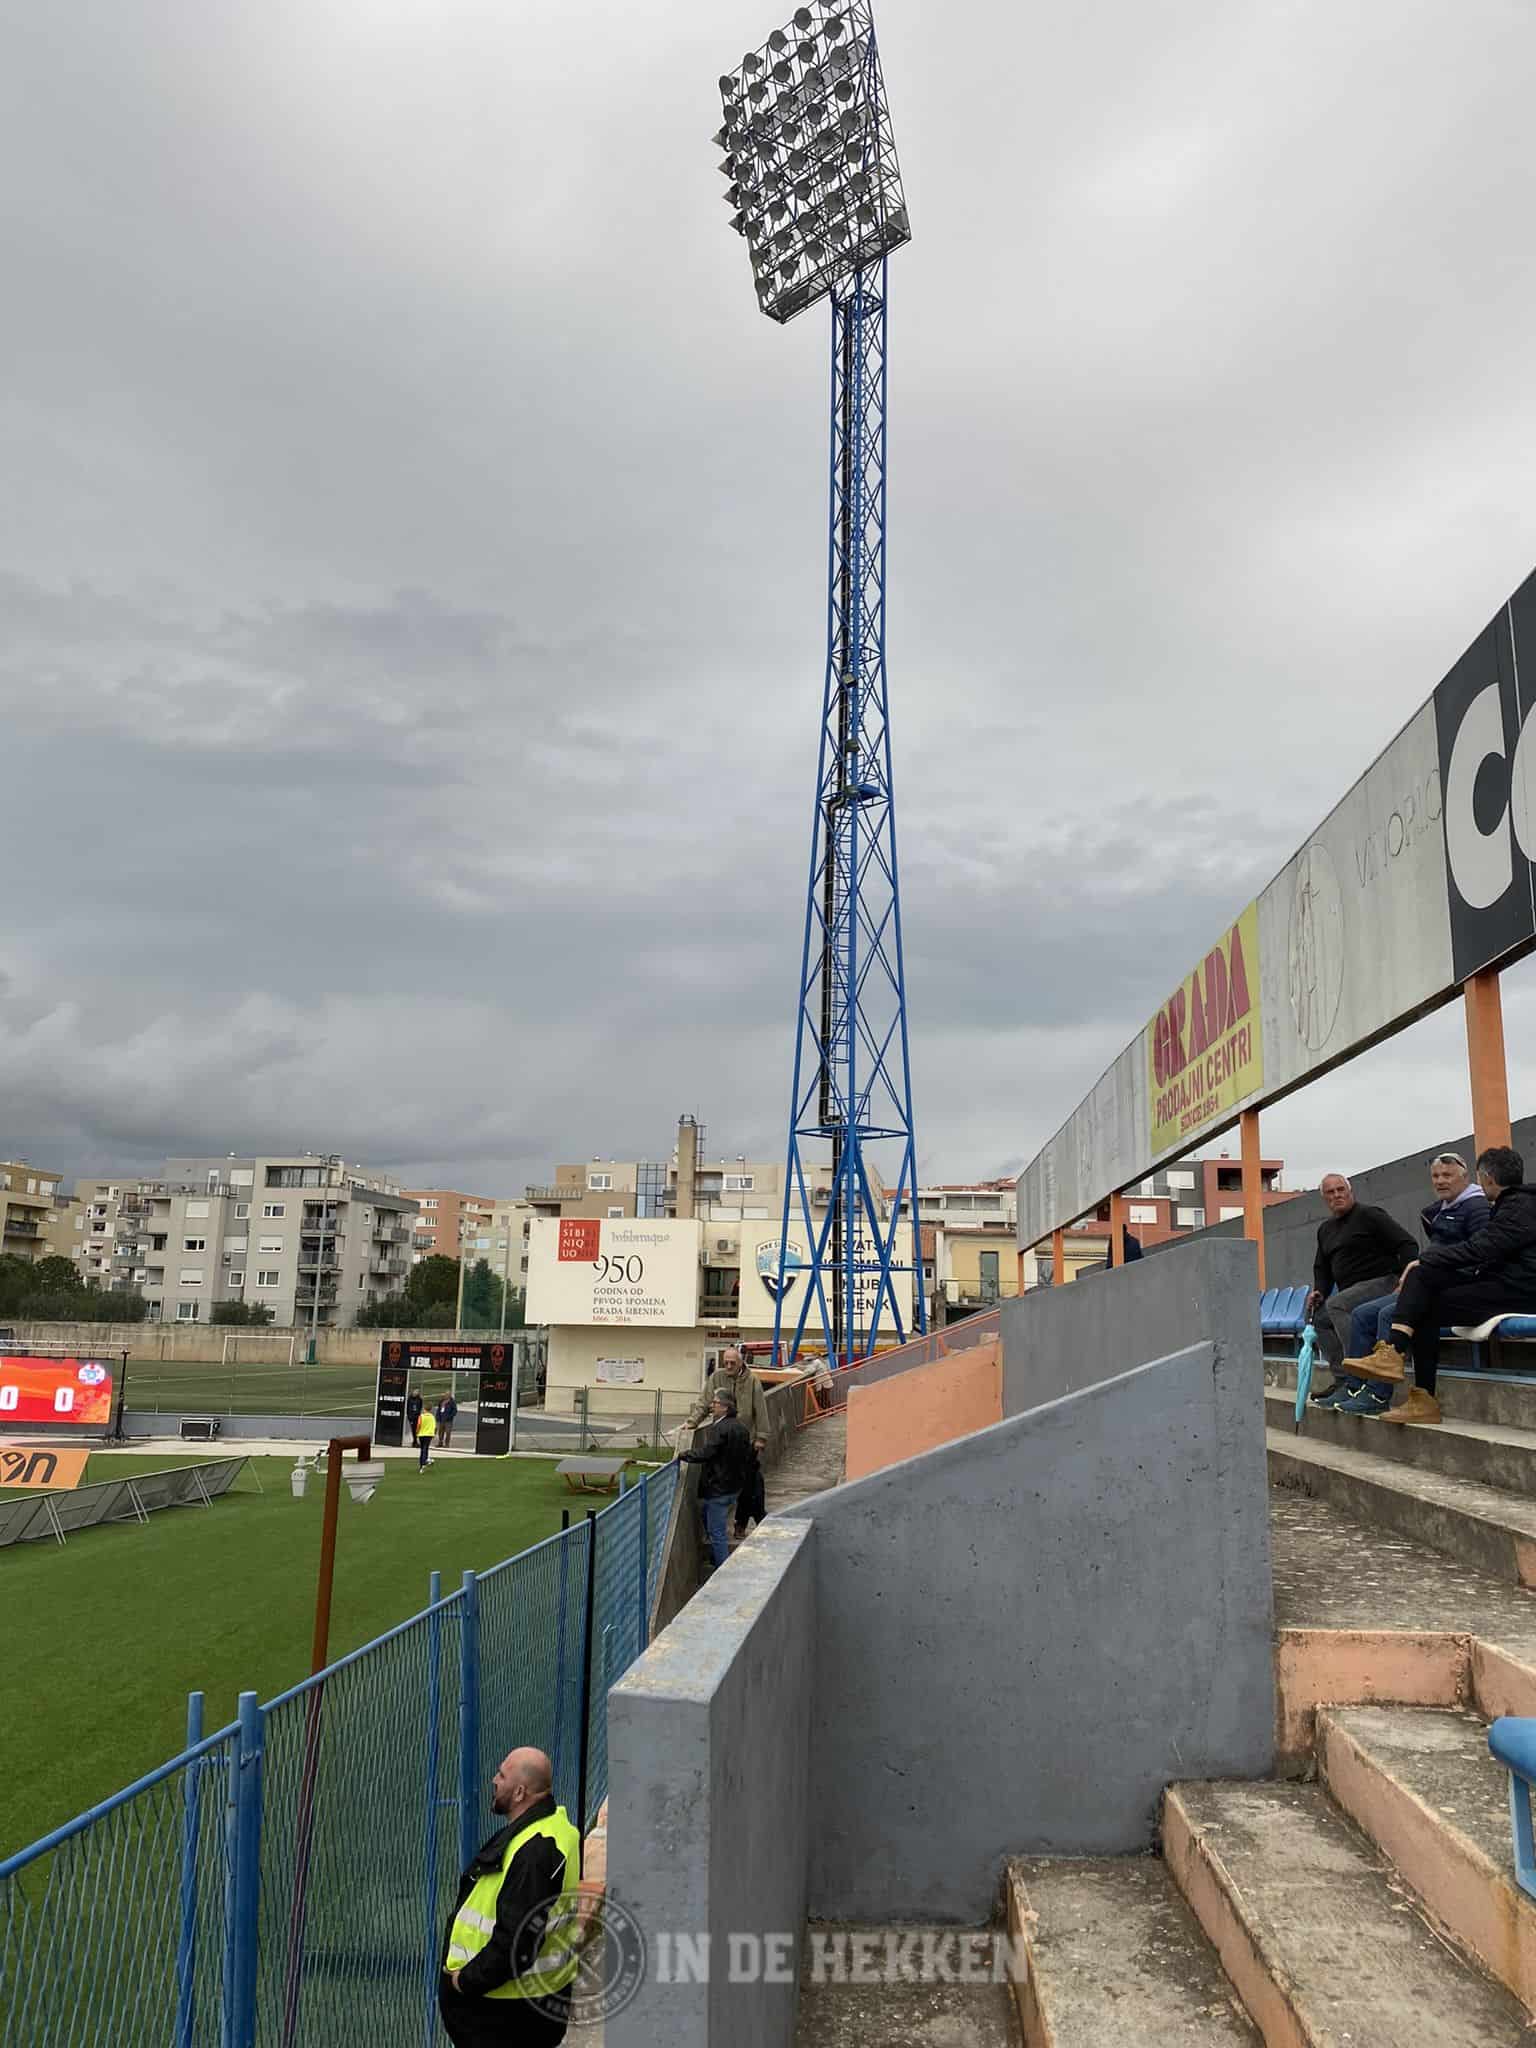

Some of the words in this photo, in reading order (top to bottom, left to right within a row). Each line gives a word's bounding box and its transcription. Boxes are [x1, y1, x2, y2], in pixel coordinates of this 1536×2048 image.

[1153, 922, 1251, 1089] GRADA
[1156, 1063, 1204, 1129] PRODAJNI
[1206, 1022, 1252, 1091] CENTRI
[562, 1228, 585, 1237] SIBI
[561, 1238, 585, 1248] NIQ
[561, 1248, 577, 1257] UO
[593, 1254, 644, 1284] 950
[593, 1287, 628, 1296] GODINA
[630, 1287, 644, 1296] OD
[593, 1297, 623, 1305] PRVOG
[625, 1297, 666, 1306] SPOMENA
[592, 1307, 623, 1315] GRADA
[0, 1385, 19, 1410] 0
[54, 1386, 75, 1412] 0
